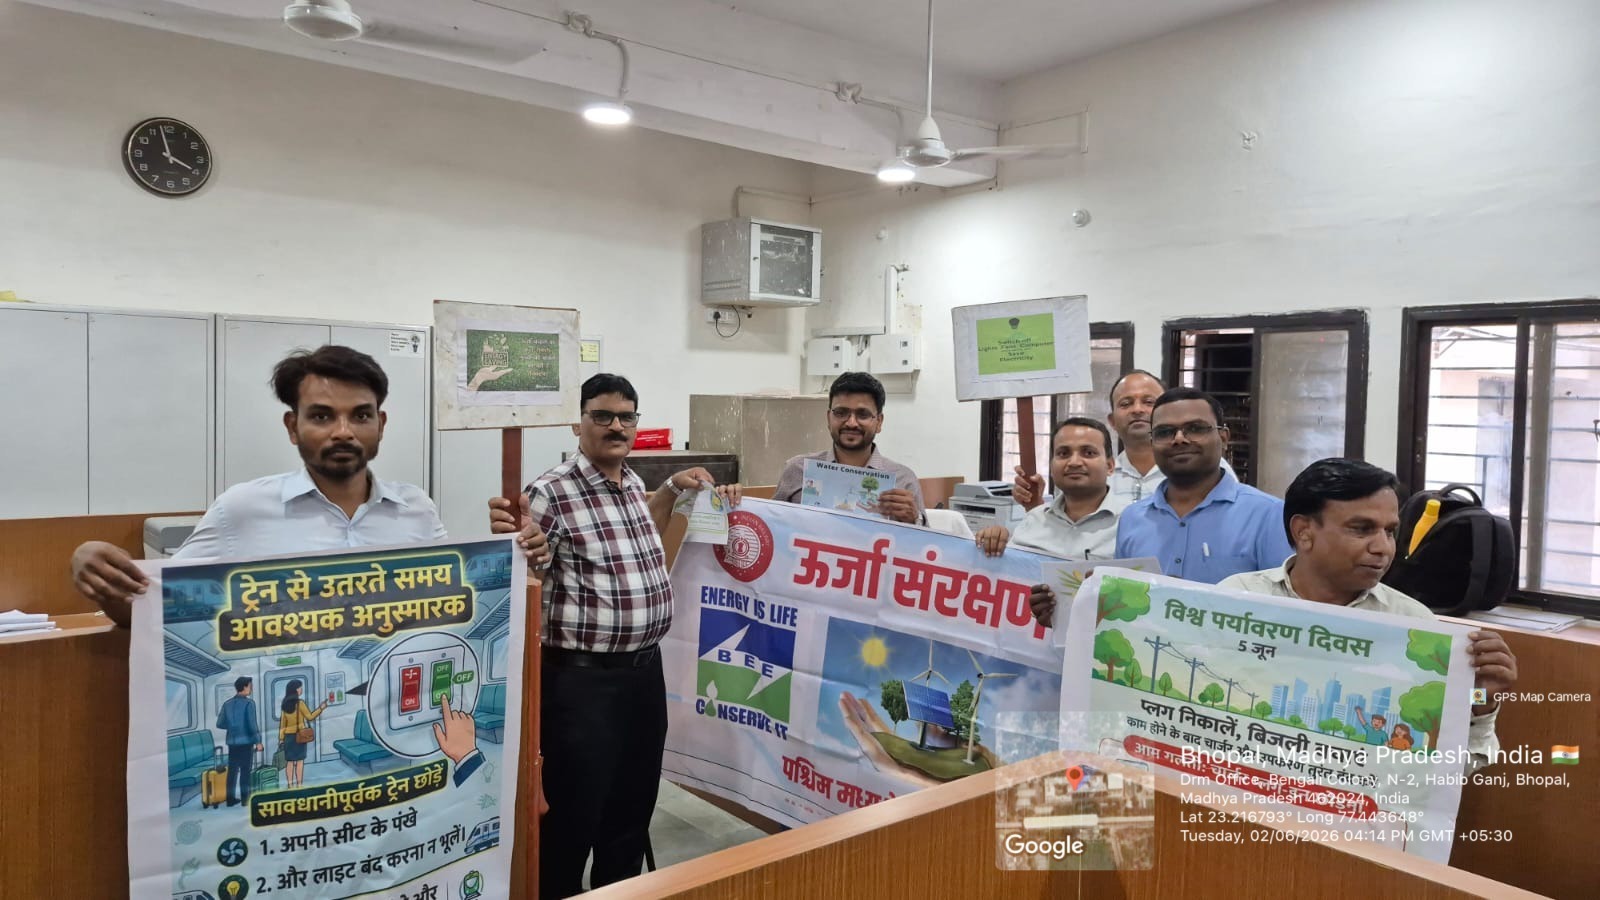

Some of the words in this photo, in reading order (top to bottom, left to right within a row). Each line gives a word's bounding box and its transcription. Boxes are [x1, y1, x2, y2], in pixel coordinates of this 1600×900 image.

[164, 125, 175, 134] 12
[134, 149, 143, 157] 9
[190, 142, 199, 150] 2
[139, 163, 148, 171] 8
[196, 155, 204, 164] 3
[151, 174, 159, 182] 7
[166, 180, 175, 188] 6
[182, 177, 190, 185] 5
[816, 461, 839, 472] Water
[840, 466, 890, 480] Conservation
[239, 574, 280, 614] ट्रेन
[285, 569, 312, 601] से
[318, 563, 388, 598] उतरते
[393, 564, 453, 590] समय
[793, 538, 890, 600] ऊर्जा
[893, 550, 1046, 640] संरक्षण
[700, 585, 750, 614] ENERGY
[753, 598, 765, 620] IS
[770, 603, 798, 628] LIFE
[230, 608, 345, 642] आवश्यक
[351, 594, 467, 633] अनुस्मारक
[1164, 598, 1207, 627] विश्व
[1211, 611, 1302, 644] पर्यावरण
[1307, 624, 1374, 657] दिवस
[1237, 640, 1247, 652] 5
[1250, 642, 1277, 662] जून
[436, 664, 449, 672] OFF
[456, 672, 473, 682] OFF
[404, 697, 416, 706] ON
[774, 723, 788, 741] IT
[1126, 716, 1148, 731] काम
[1150, 721, 1167, 737] होने
[1170, 725, 1181, 739] के
[1204, 737, 1234, 752] चार्जर
[1141, 699, 1175, 721] प्लग
[1179, 706, 1241, 741] निकालें,
[1247, 722, 1311, 754] बिजली
[1134, 742, 1161, 760] आम
[782, 755, 833, 799] पश्चिम
[258, 781, 383, 819] सावधानीपूर्वक
[387, 774, 410, 802] ट्रेन
[413, 762, 444, 790] छोड़ें
[260, 839, 275, 856] 1.
[280, 826, 327, 853] अपनी
[333, 821, 367, 844] सीट
[371, 816, 388, 837] के
[392, 807, 418, 832] पंखे
[256, 877, 272, 894] 2.
[277, 865, 308, 890] और
[313, 863, 356, 884] लाइट
[360, 855, 383, 875] बंद
[386, 843, 425, 868] करना
[427, 841, 438, 855] न
